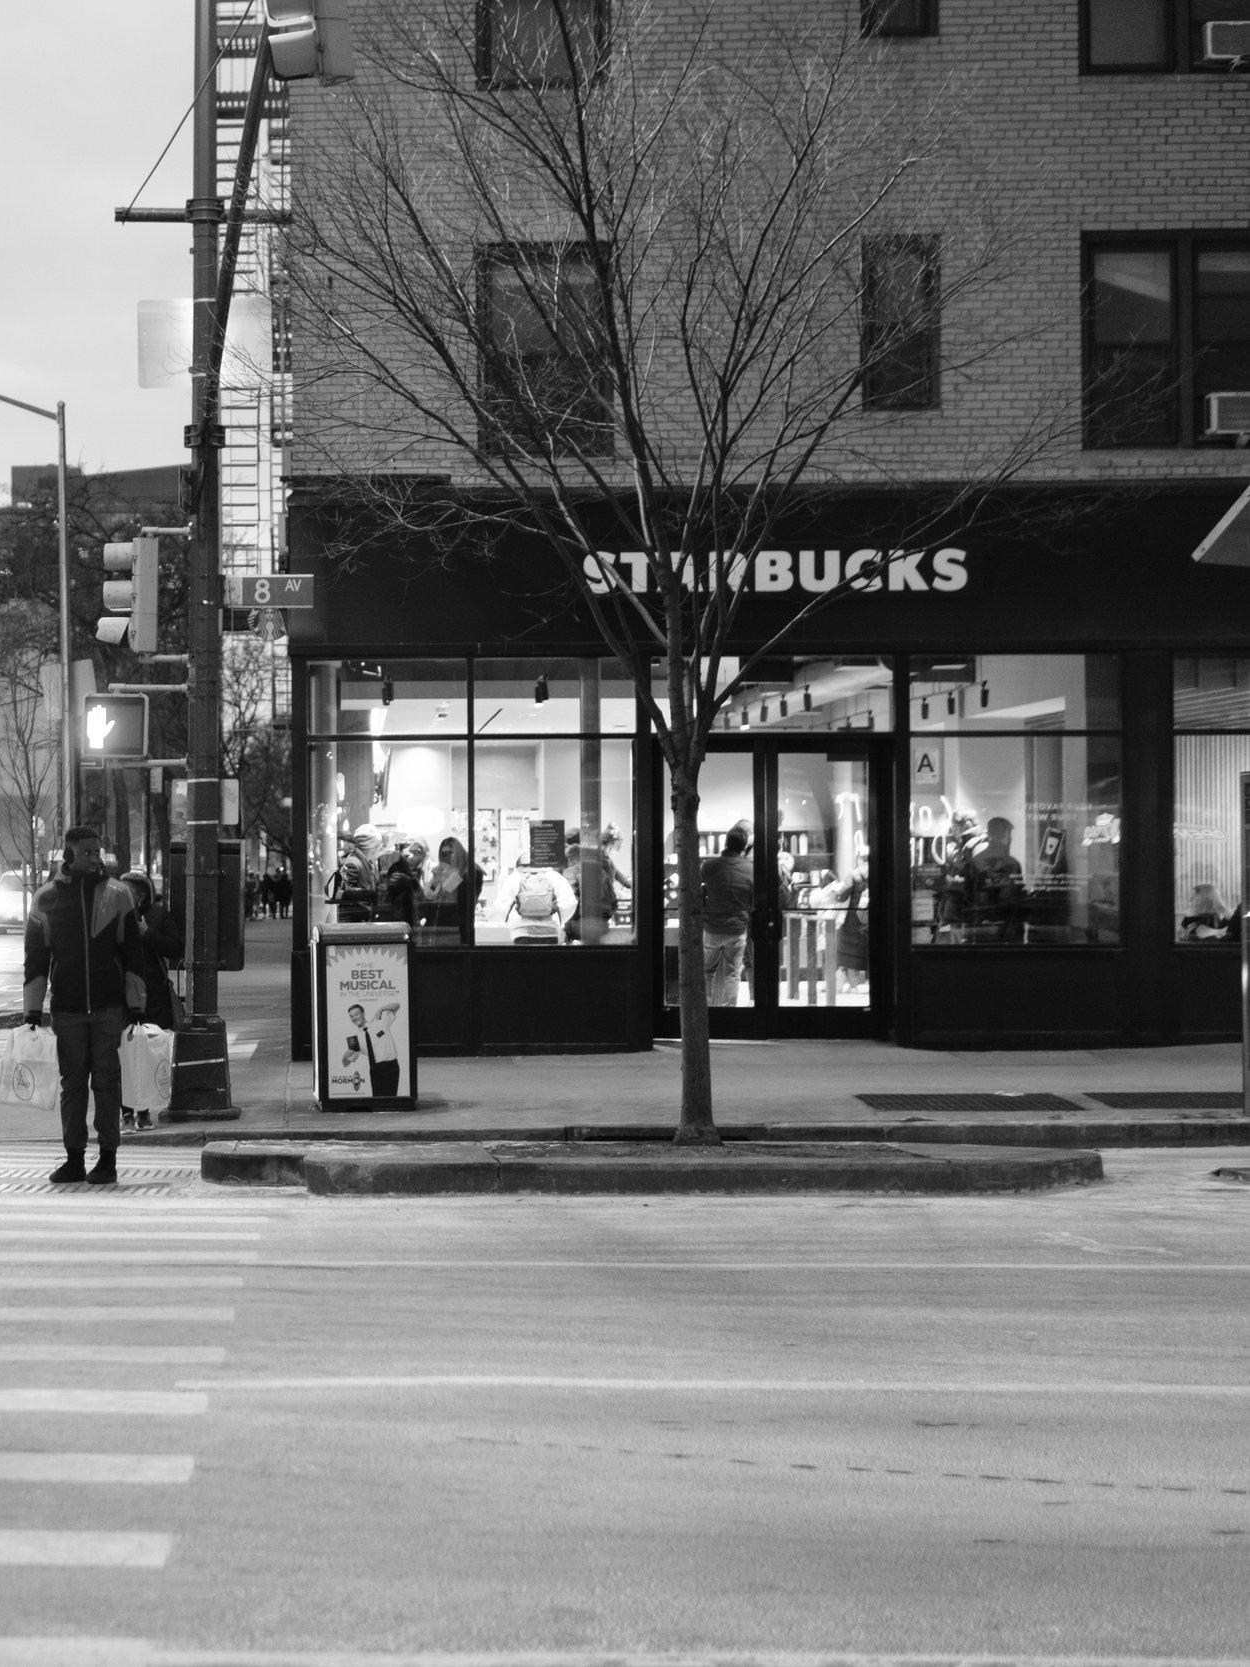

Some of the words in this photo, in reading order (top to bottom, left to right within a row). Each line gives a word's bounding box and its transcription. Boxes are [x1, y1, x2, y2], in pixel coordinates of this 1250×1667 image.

[254, 578, 271, 604] 8
[284, 579, 302, 592] AV
[917, 753, 935, 773] A
[351, 969, 384, 980] BEST
[339, 979, 396, 991] MUSICAL
